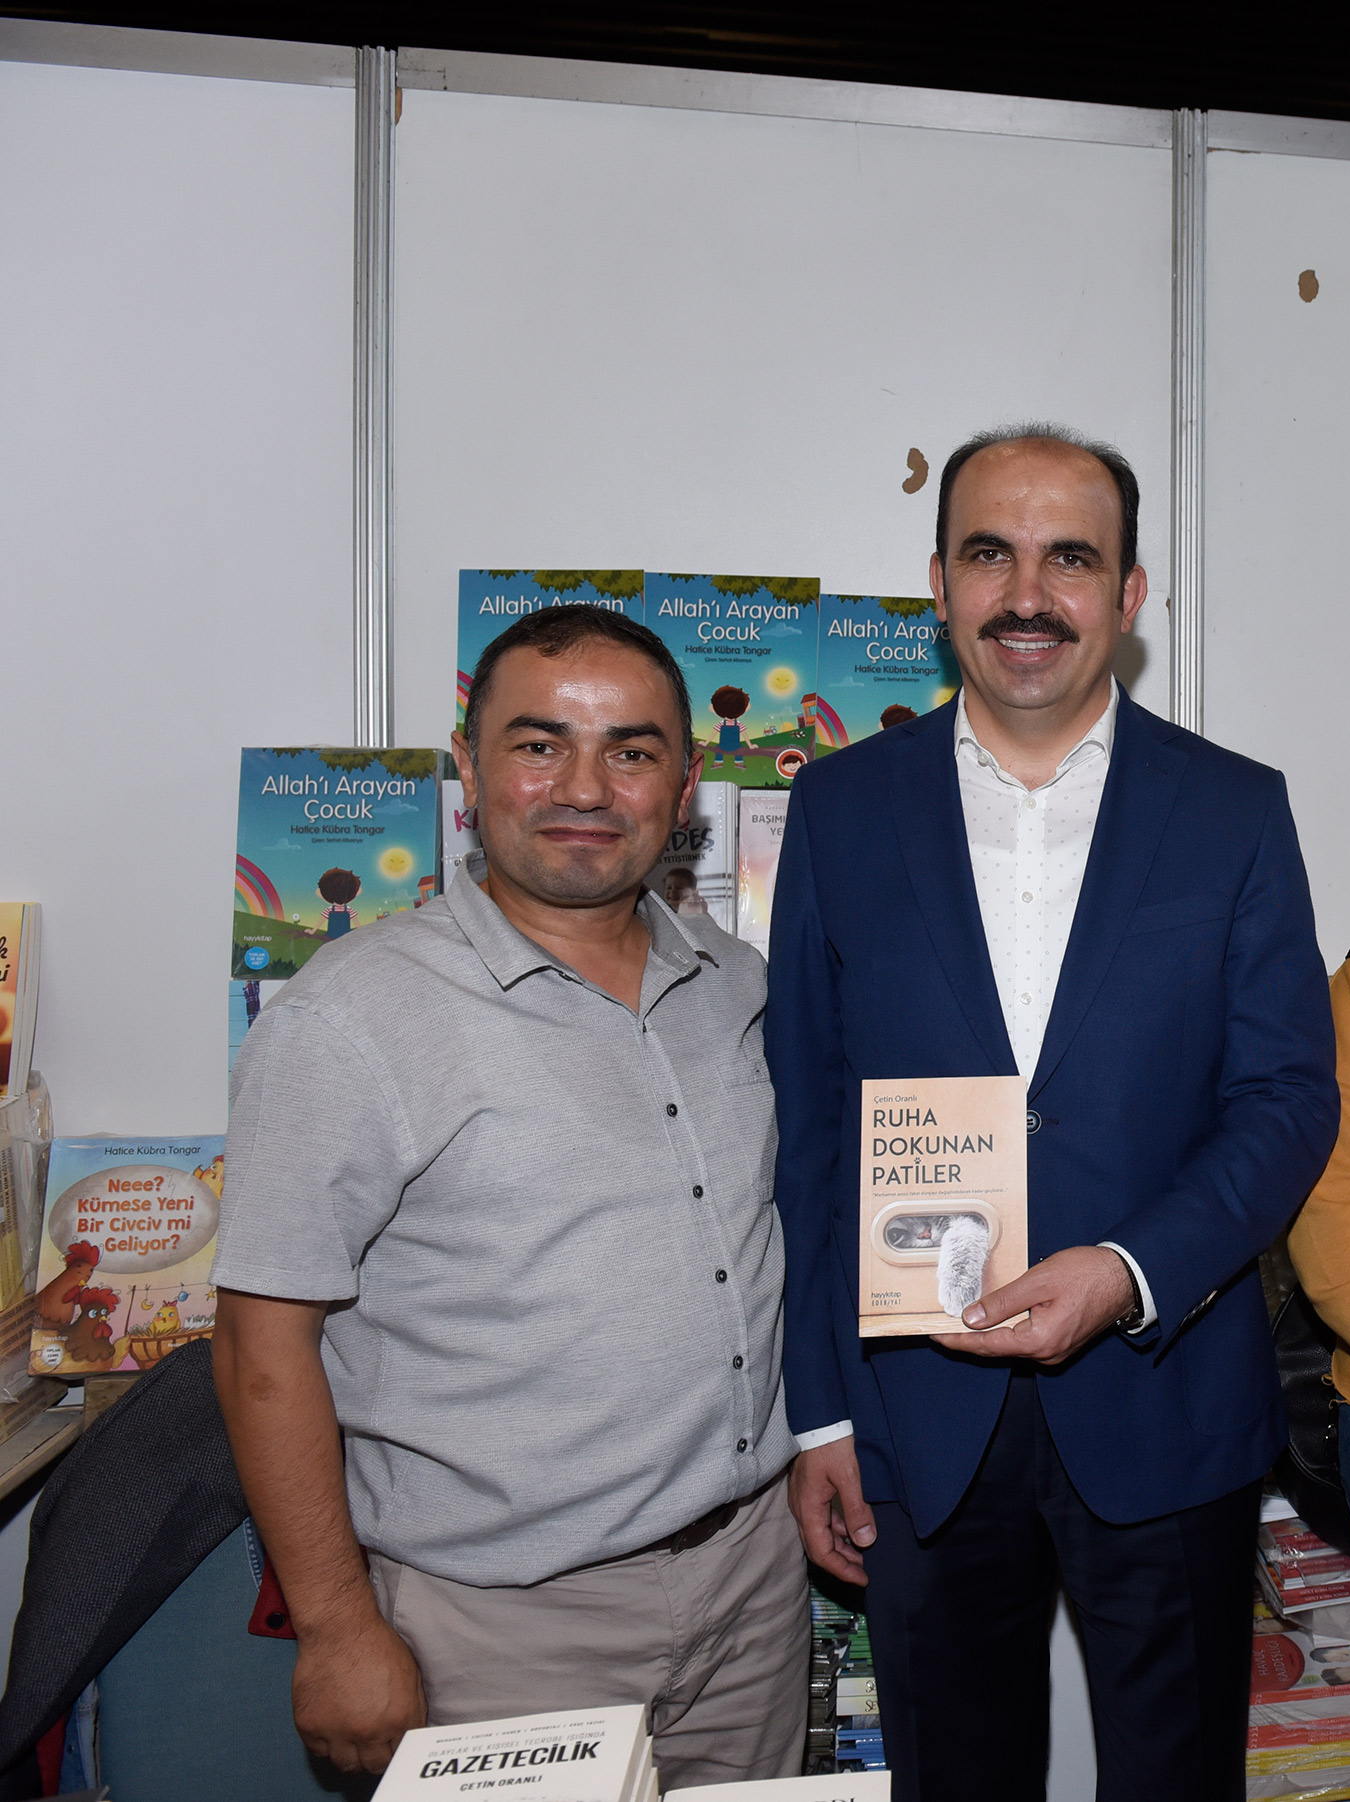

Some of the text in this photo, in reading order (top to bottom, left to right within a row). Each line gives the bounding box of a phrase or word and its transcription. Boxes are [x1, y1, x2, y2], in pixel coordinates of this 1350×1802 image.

[658, 598, 799, 624] Allah'ı Arayan
[698, 621, 761, 643] Çocuk
[828, 619, 951, 644] Allah'ı Araya
[685, 645, 772, 657] Hatice Kübra Tongar
[866, 642, 928, 664] Çocuk
[855, 665, 939, 676] Hatice Kübra Tongar
[261, 775, 415, 800] Allah'ı Arayan
[304, 799, 373, 823] Çocuk
[290, 825, 386, 836] Hatice Kübra Tongar
[873, 1094, 918, 1104] Çetin Oranlı
[873, 1108, 938, 1128] RUHA
[104, 1146, 201, 1156] Hatice Kübra Tongar
[873, 1134, 994, 1157] DOKUNAN
[873, 1158, 962, 1185] PATİLER
[108, 1176, 164, 1192] Neee?
[78, 1196, 194, 1213] Kümese Yeni
[77, 1215, 191, 1233] Bir Civciv mi
[105, 1234, 180, 1256] Geliyor?
[871, 1291, 901, 1300] hayykitap
[419, 1740, 602, 1779] GAZETECİLİK
[498, 1774, 543, 1787] ORANLI
